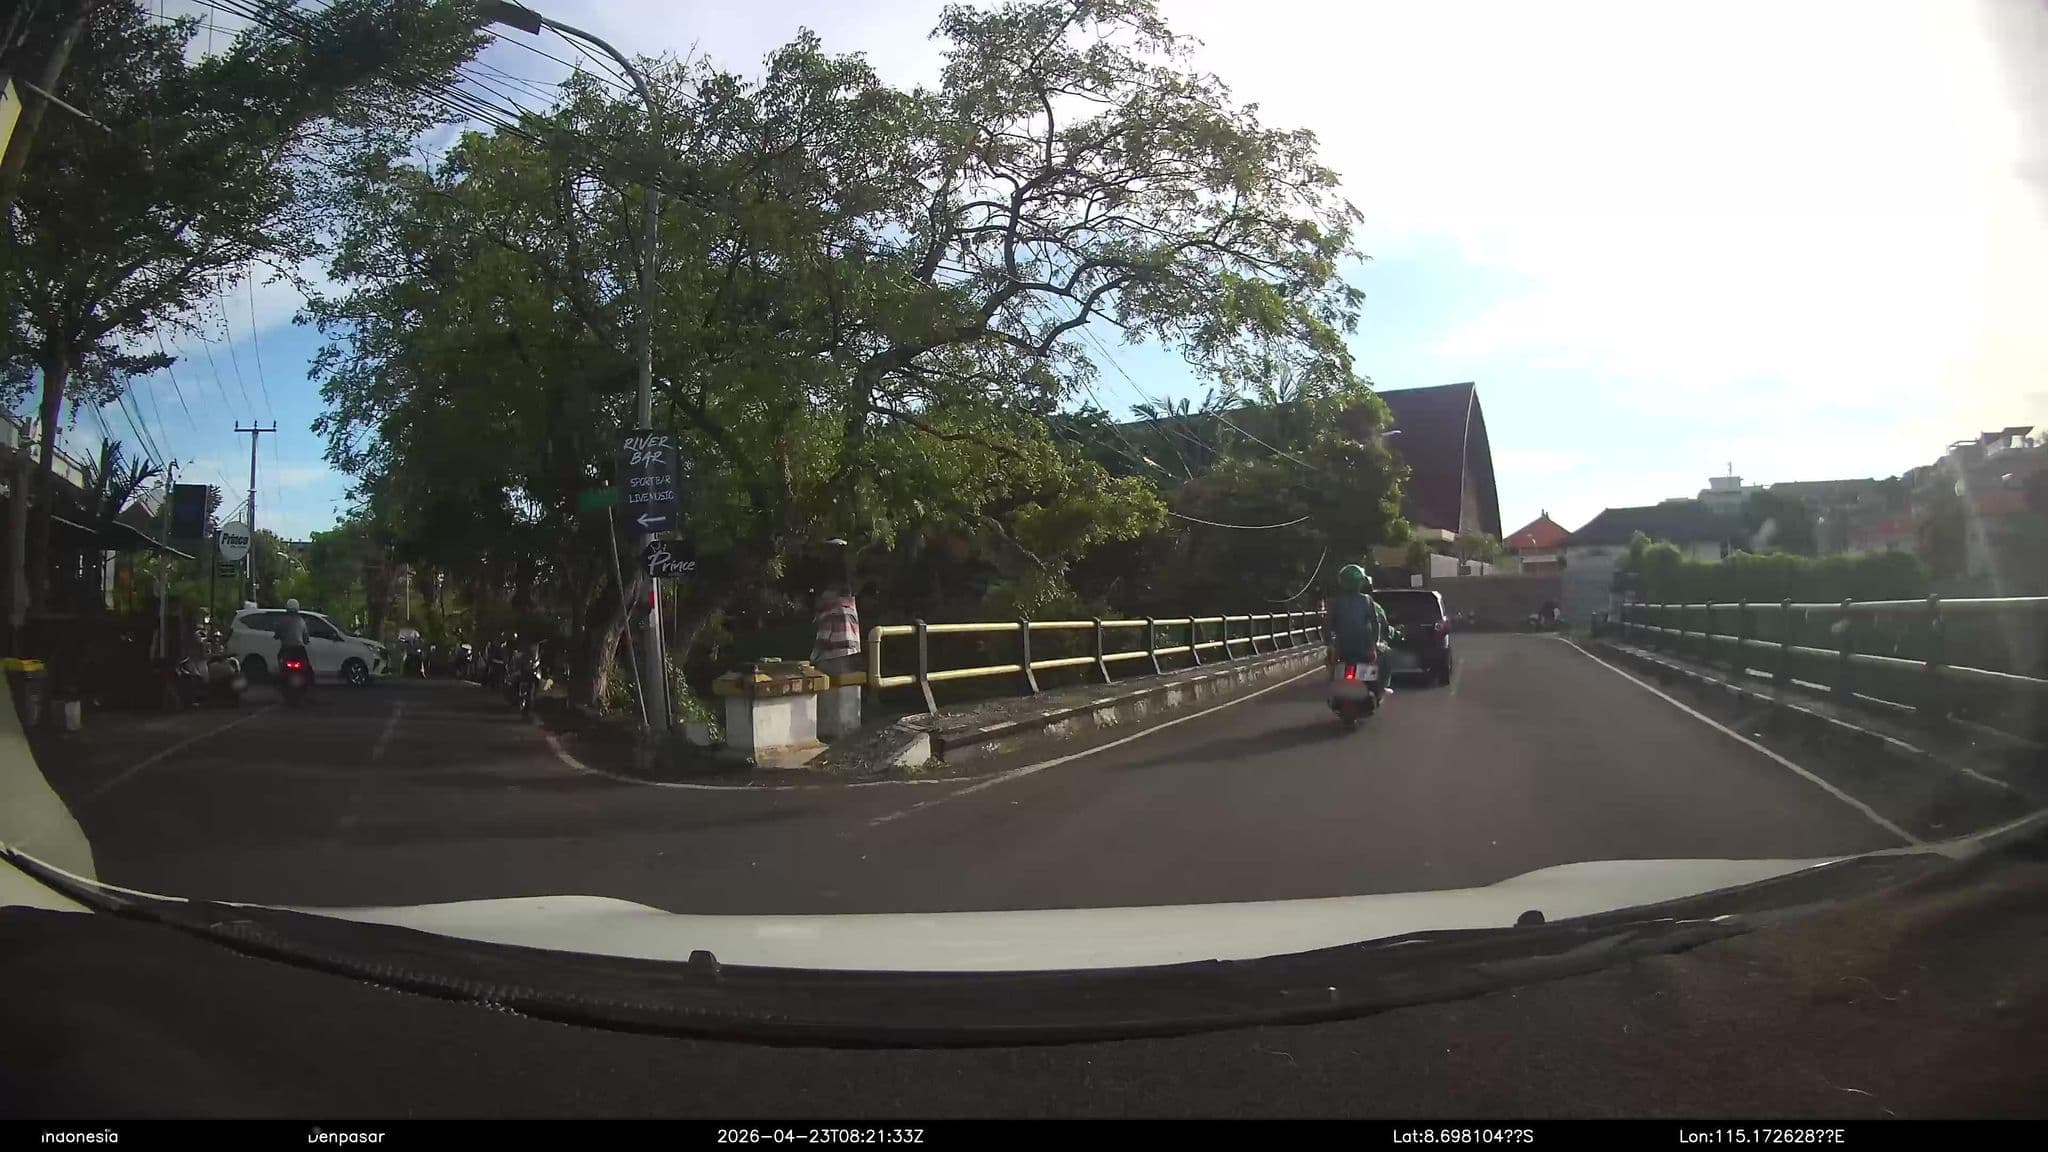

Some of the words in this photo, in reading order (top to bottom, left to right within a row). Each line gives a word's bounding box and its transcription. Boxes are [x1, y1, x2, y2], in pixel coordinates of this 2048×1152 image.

[623, 433, 674, 451] RIVER
[629, 451, 667, 468] BAR
[630, 476, 654, 487] SPORT
[655, 475, 671, 485] BAR
[629, 492, 648, 503] LIVE
[648, 550, 696, 576] Prince
